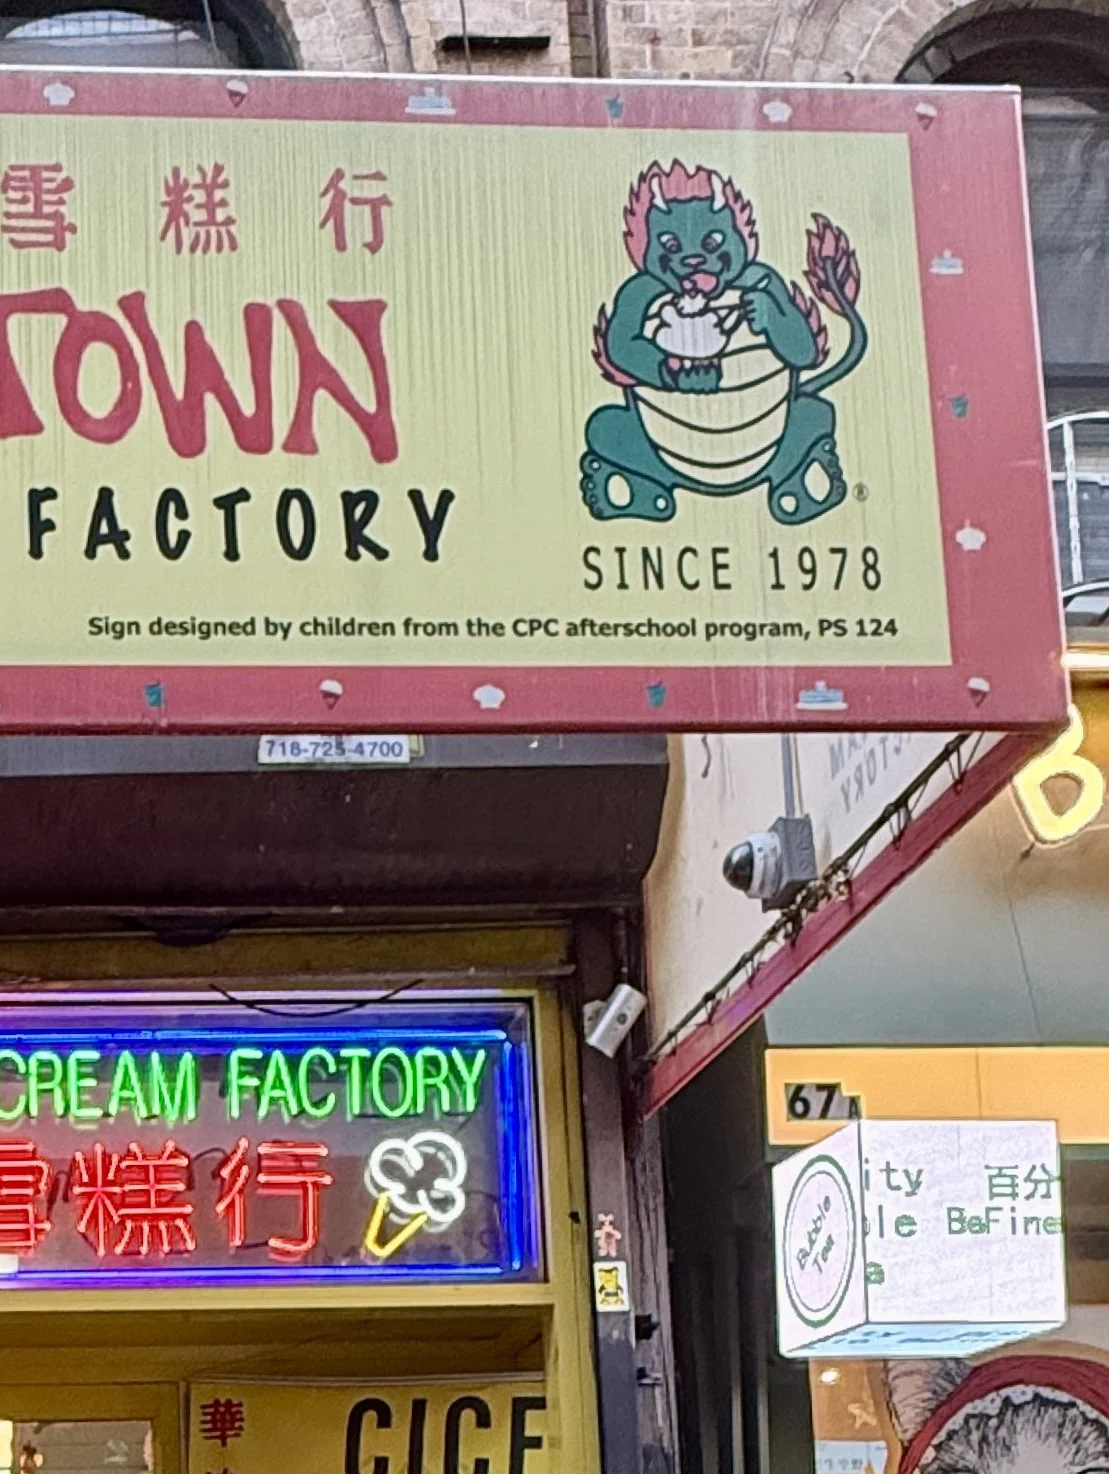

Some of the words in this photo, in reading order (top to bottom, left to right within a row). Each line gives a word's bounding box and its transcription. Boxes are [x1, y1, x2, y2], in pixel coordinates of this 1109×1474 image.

[26, 487, 455, 562] FACTORY
[582, 545, 733, 592] SINCE
[769, 545, 884, 592] 1978
[88, 617, 141, 640] Sign
[148, 616, 256, 640] designed
[264, 616, 292, 640] by
[299, 616, 394, 637] children
[403, 616, 459, 637] from
[466, 617, 505, 637] the
[512, 618, 559, 637] CPC
[565, 616, 697, 637] afterschool
[705, 620, 811, 642] program,
[818, 619, 848, 637] PS
[856, 619, 898, 637] 124
[229, 1046, 486, 1118] FACTORY
